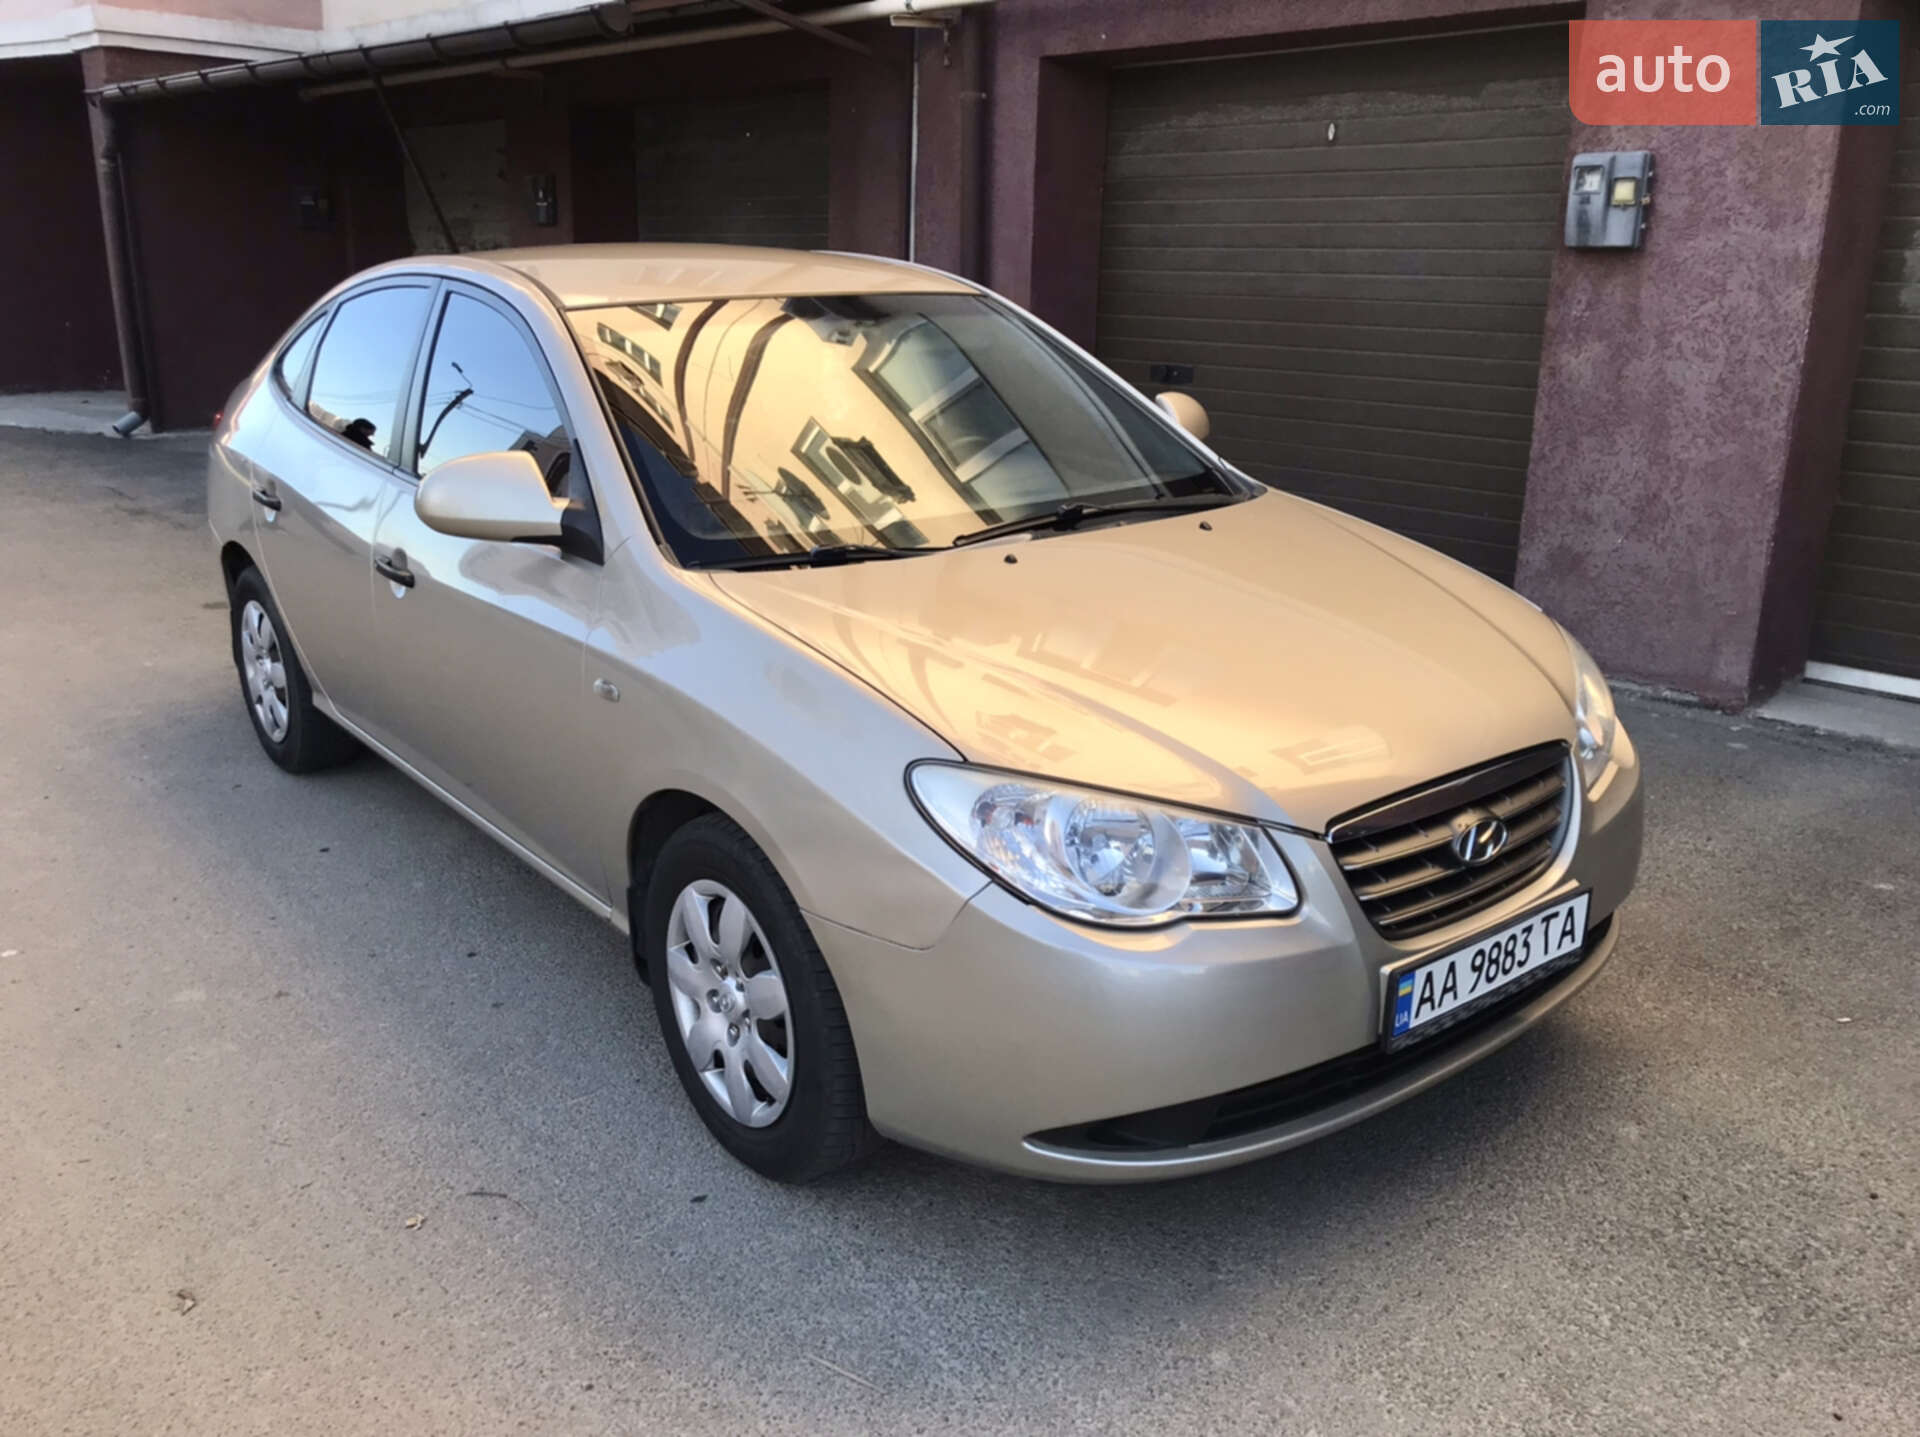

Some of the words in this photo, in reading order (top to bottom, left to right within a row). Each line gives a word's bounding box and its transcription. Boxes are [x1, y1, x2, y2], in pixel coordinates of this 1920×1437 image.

[1414, 961, 1458, 1019] AA
[1469, 923, 1533, 994] 9883
[1541, 906, 1576, 956] TA
[1395, 1011, 1409, 1028] UA
